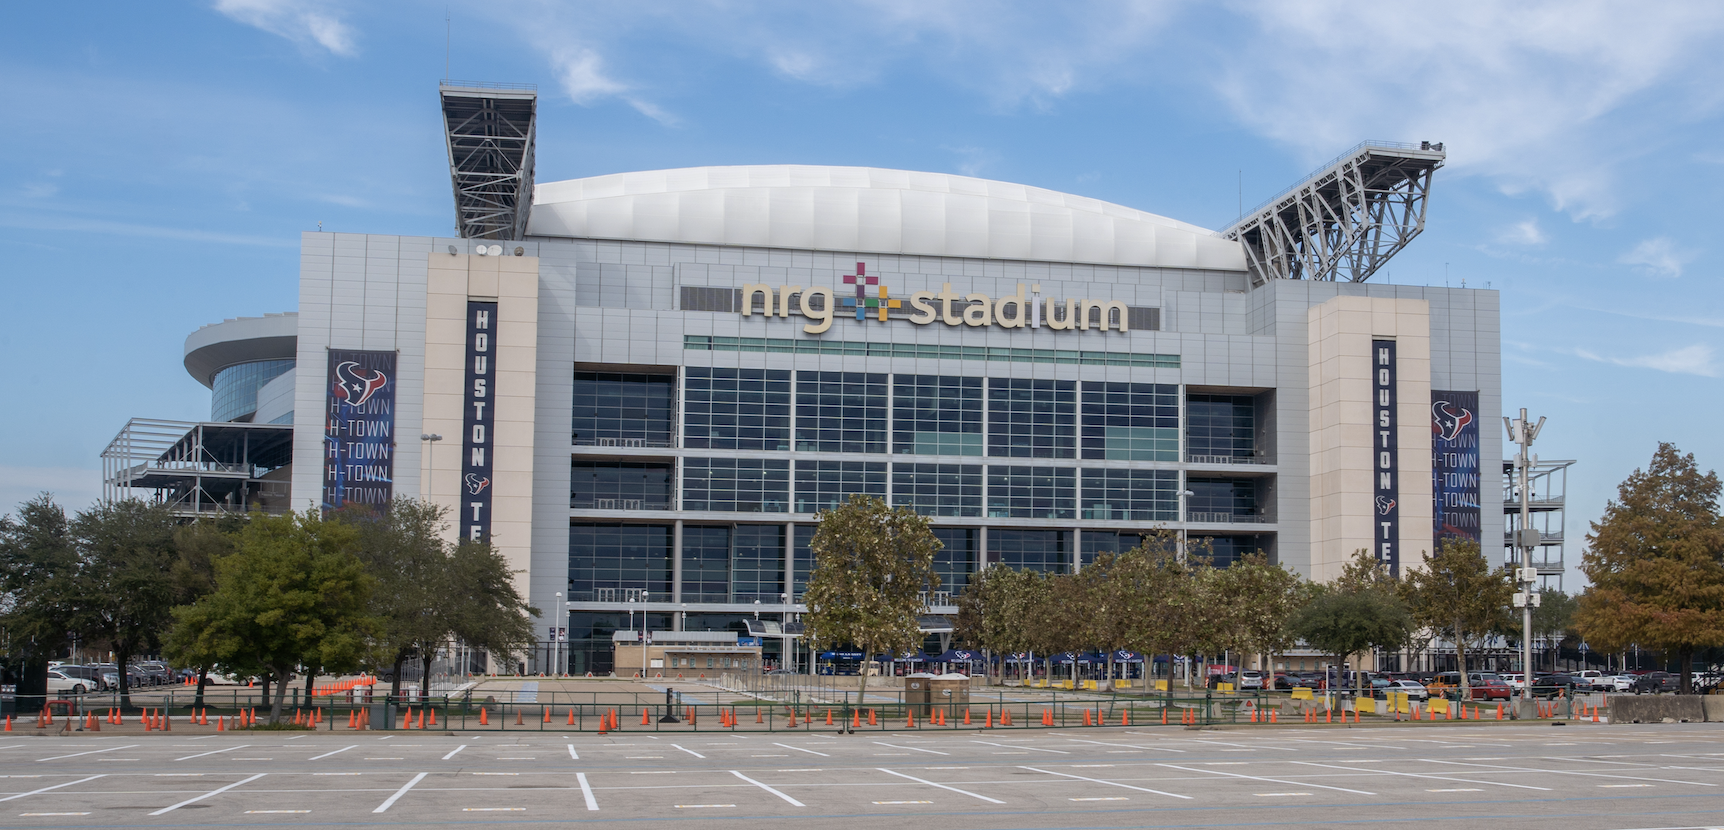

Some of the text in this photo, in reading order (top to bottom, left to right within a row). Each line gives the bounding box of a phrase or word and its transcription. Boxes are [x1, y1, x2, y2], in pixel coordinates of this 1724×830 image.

[742, 282, 1129, 334] nrg stadium
[332, 352, 392, 370] HTOWN
[471, 310, 489, 467] HOUSTON
[1379, 347, 1391, 490] HOUSTON
[330, 419, 389, 437] H-TOWN
[328, 441, 388, 460] H-TOWN
[328, 464, 388, 482] H-TOWN
[327, 486, 387, 504] H-TOWN
